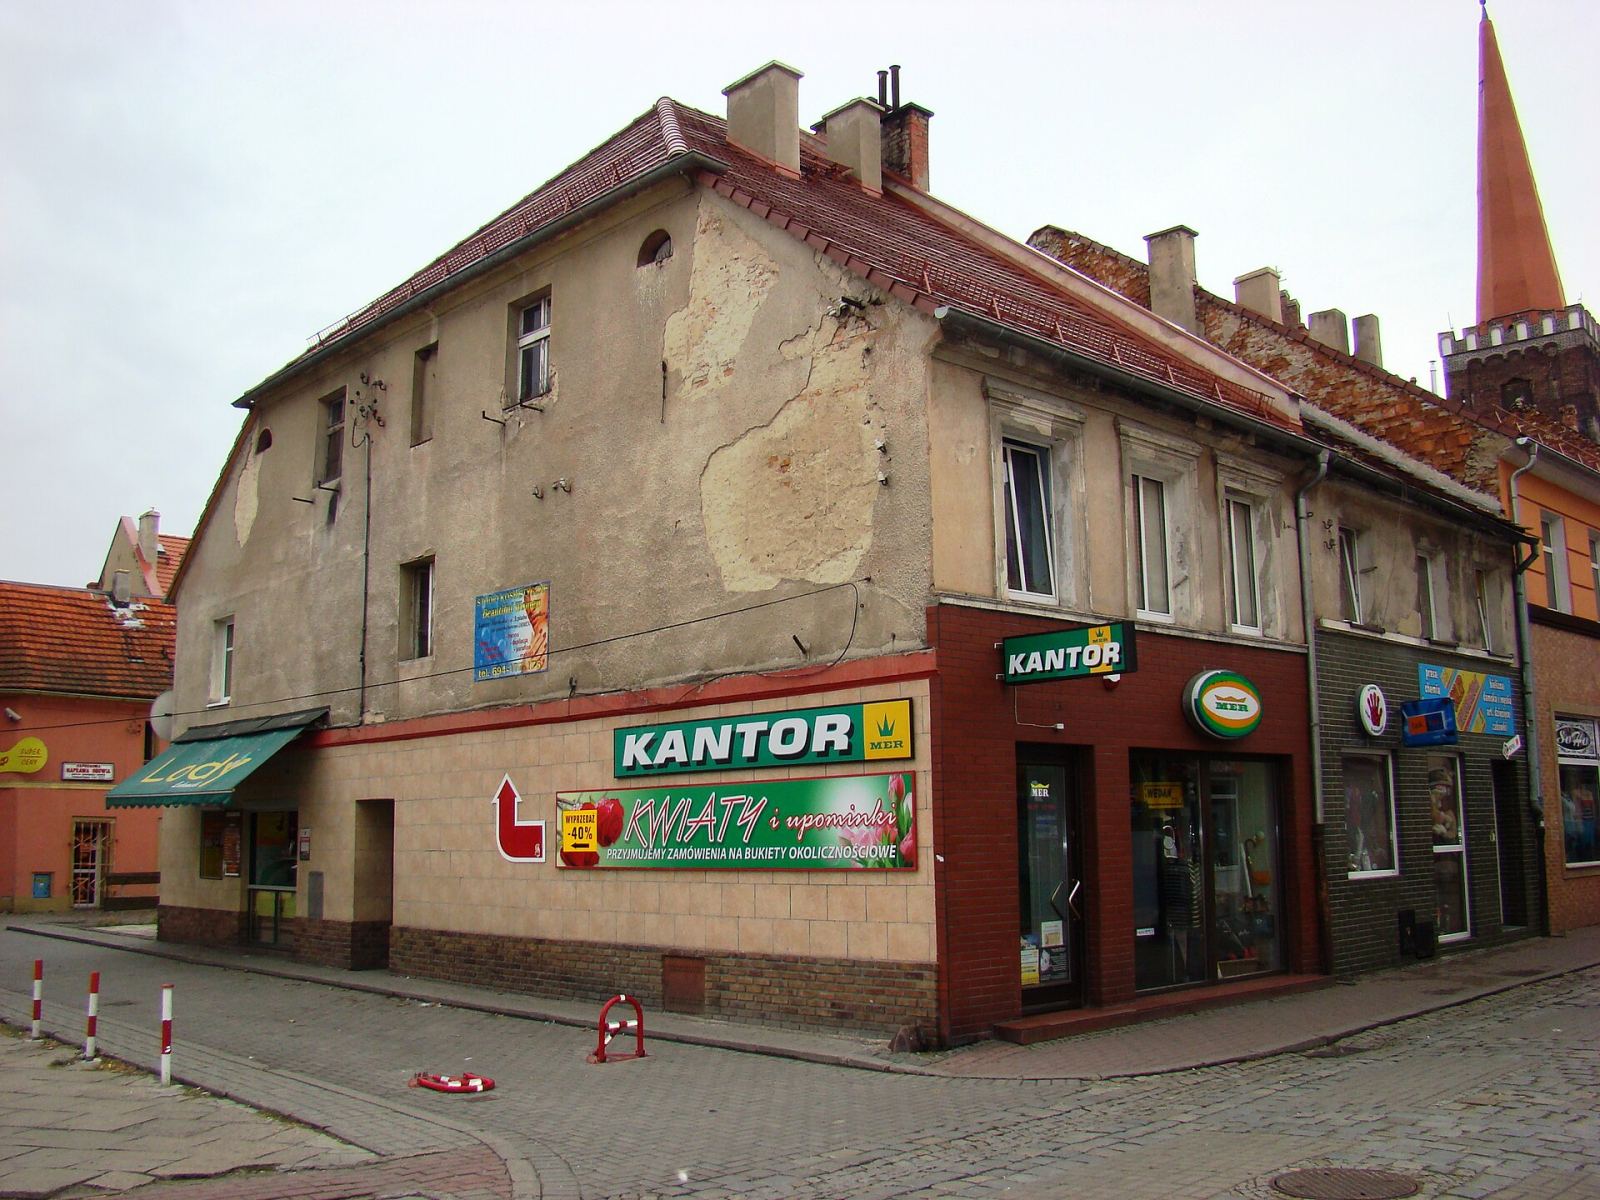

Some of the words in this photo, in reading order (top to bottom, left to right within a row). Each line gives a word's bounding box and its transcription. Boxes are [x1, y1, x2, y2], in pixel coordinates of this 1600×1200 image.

[1008, 642, 1120, 674] KANTOR
[1215, 701, 1249, 712] MER
[622, 713, 852, 767] KANTOR
[869, 740, 903, 750] MER
[1031, 789, 1050, 797] MER
[624, 791, 768, 849] KWIATY
[768, 807, 780, 829] i
[786, 801, 897, 840] upominki
[567, 826, 593, 840] -40%
[606, 846, 667, 861] PRZYJMUJEMY
[668, 846, 727, 860] ZAMÓWIENIA
[729, 847, 743, 859] NA
[744, 846, 787, 859] BUKIETY
[788, 843, 897, 860] OKOLICZNOŚCIOWE
